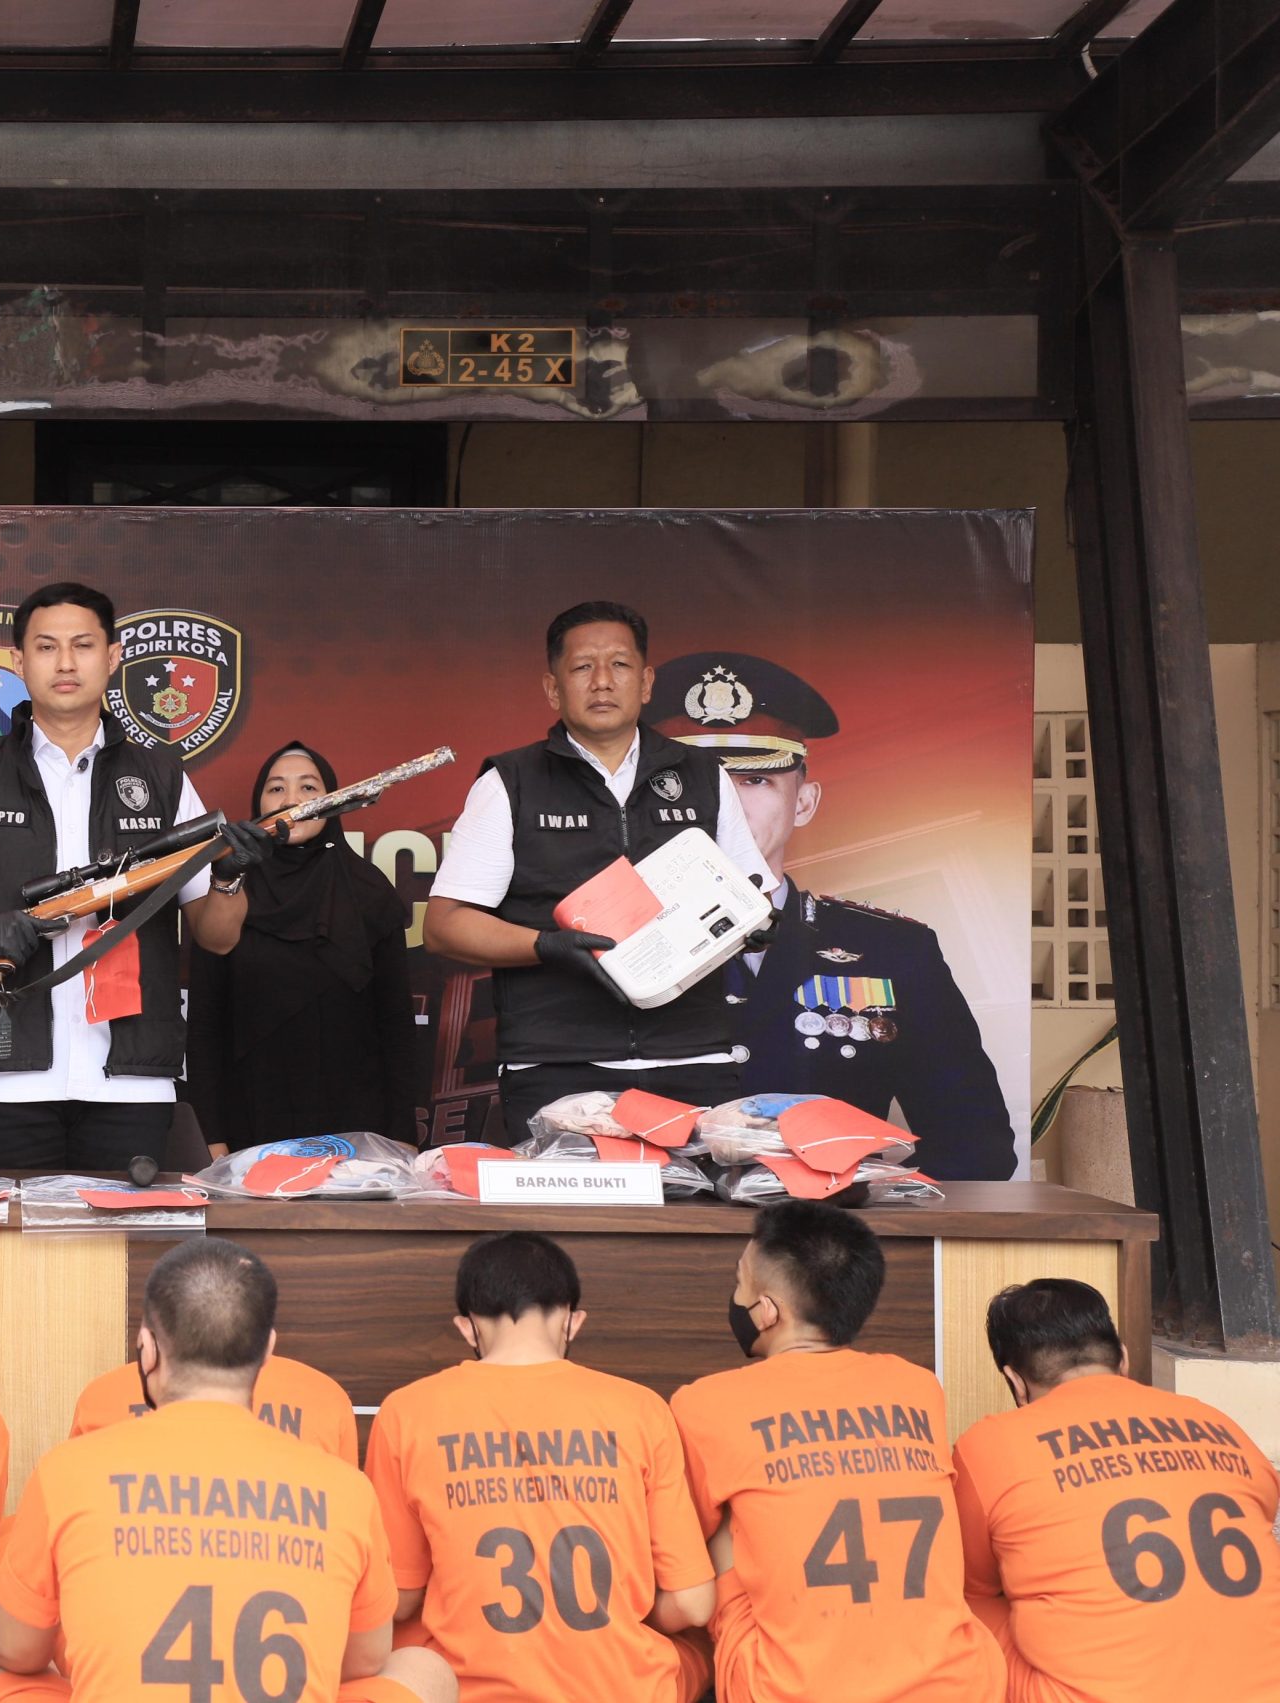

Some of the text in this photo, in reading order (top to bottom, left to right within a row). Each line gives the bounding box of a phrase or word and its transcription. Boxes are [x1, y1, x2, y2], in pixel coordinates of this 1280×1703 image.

[120, 620, 222, 647] POLRES
[177, 639, 229, 667] KOTA
[107, 688, 158, 750] RESERSE
[180, 688, 233, 752] KRIMINAL
[119, 817, 162, 830] KASAT
[539, 813, 588, 829] IWAN
[658, 807, 697, 822] KBO
[656, 902, 681, 922] EPSON
[515, 1176, 627, 1188] BARANG BUKTI
[751, 1404, 932, 1453] TAHANAN
[1036, 1416, 1241, 1460] TAHANAN
[437, 1430, 618, 1473] TAHANAN
[764, 1451, 835, 1485] POLRES
[839, 1447, 902, 1475] KEDIRI
[1053, 1449, 1253, 1494] POLRES KEDIRI KOTA
[109, 1473, 328, 1531] TAHANAN
[445, 1474, 619, 1510] POLRES KEDIRI KOTA
[114, 1526, 325, 1573] POLRES KEDIRI KOTA
[803, 1495, 945, 1604] 47
[1101, 1492, 1262, 1603] 66
[475, 1525, 612, 1634] 30
[140, 1584, 308, 1703] 46
